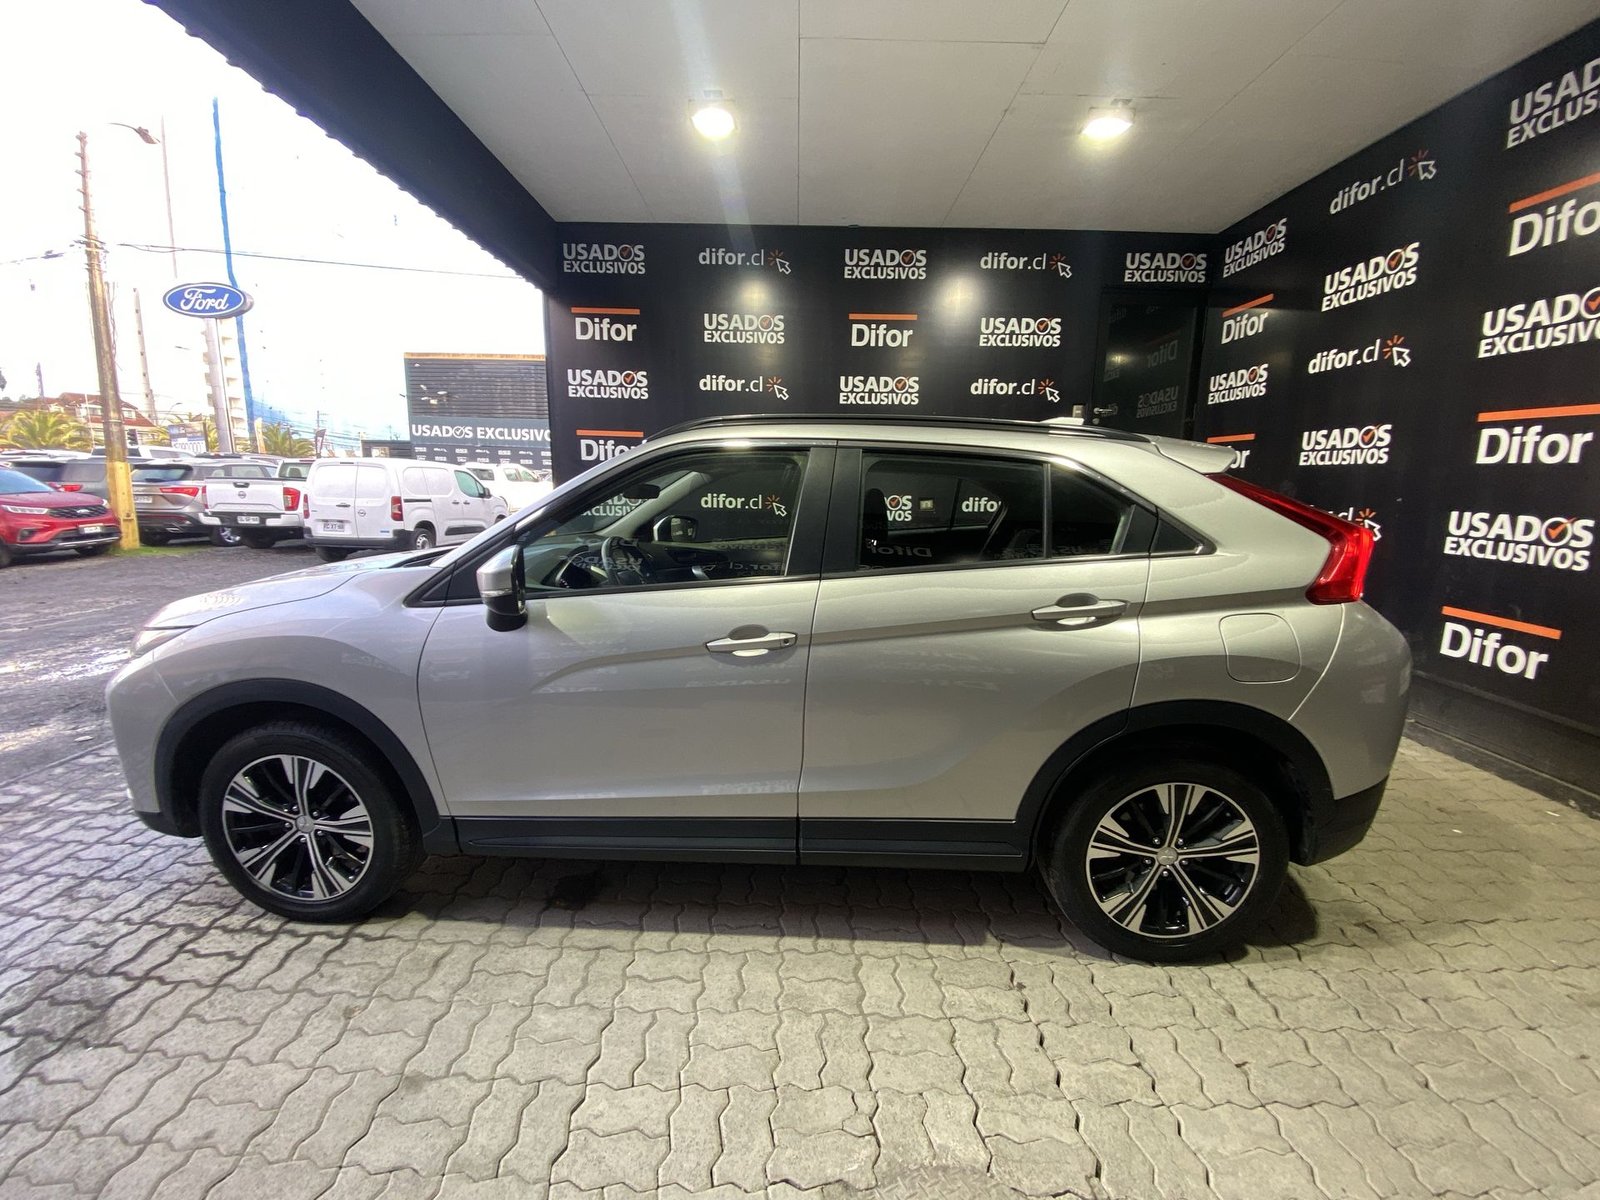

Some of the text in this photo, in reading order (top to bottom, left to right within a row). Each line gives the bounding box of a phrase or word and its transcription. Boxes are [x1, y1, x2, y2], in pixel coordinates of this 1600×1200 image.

[1506, 89, 1600, 150] EXCLUS
[1329, 158, 1404, 215] difor.cl
[1225, 217, 1288, 264] USADOS
[563, 243, 646, 262] USADOS
[698, 248, 765, 267] difor.cl
[844, 248, 927, 267] USADOS
[979, 252, 1047, 271] difor.cl
[1125, 252, 1207, 271] USADOS
[1223, 237, 1286, 278] EXCLUSIVOS
[563, 261, 646, 275] EXCLUSIVOS
[844, 266, 927, 280] EXCLUSIVOS
[1124, 269, 1206, 283] EXCLUSIVOS
[1324, 242, 1420, 295] USADOS
[180, 287, 230, 311] Ford
[1321, 267, 1418, 312] EXCLUSIVOS
[575, 317, 638, 341] Difor
[703, 313, 785, 332] USADOS
[979, 317, 1062, 336] USADOS
[1221, 311, 1269, 345] Difor
[703, 331, 785, 344] EXCLUSIVOS
[850, 323, 914, 348] Difor
[978, 333, 1061, 348] EXCLUSIVOS
[1308, 339, 1381, 375] difor.cl
[567, 369, 649, 387] USADOS
[699, 374, 764, 393] difor.cl
[839, 375, 920, 394] USADOS
[970, 378, 1036, 396] difor.cl
[1209, 363, 1269, 392] USADOS
[567, 385, 649, 400] EXCLUSIVOS
[839, 391, 919, 406] EXCLUSIVOS
[1207, 382, 1267, 405] EXCLUSIVOS
[411, 424, 473, 439] USADOS
[1302, 423, 1393, 451] USADOS
[1475, 425, 1594, 465] Difor
[1298, 447, 1389, 466] EXCLUSIVOS
[700, 492, 763, 511] difor.cl
[1448, 510, 1596, 549] USADOS
[1443, 536, 1592, 572] EXCLUSIVOS
[1439, 621, 1549, 680] Difor
